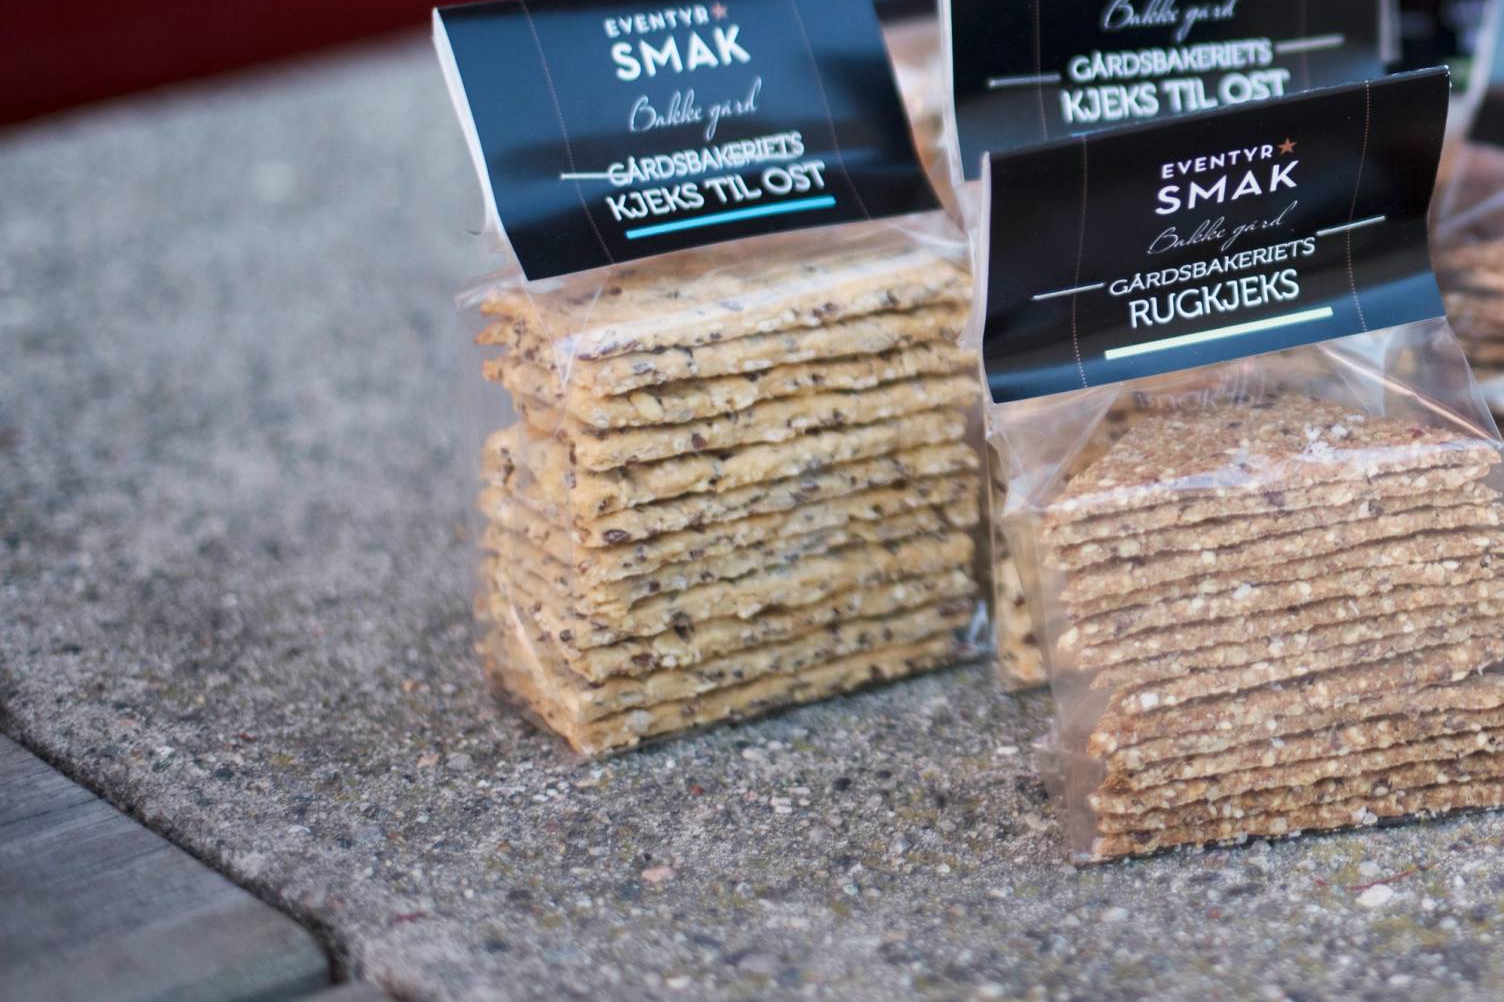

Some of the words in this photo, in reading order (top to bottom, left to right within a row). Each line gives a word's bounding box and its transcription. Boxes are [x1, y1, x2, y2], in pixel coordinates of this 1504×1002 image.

[605, 5, 708, 38] EVENTYR
[611, 25, 750, 81] SMAK
[1070, 39, 1273, 82] GÅRDSBAKERIETS
[1060, 83, 1159, 124] KJEKS
[1164, 78, 1219, 114] TIL
[1220, 69, 1290, 103] OST
[607, 132, 805, 187] GÅRDSBAKERIETS
[1154, 159, 1300, 215] SMAK
[1161, 144, 1274, 180] EVENTYR
[606, 183, 704, 222] KJEKS
[705, 171, 761, 206] TIL
[763, 160, 825, 194] OST
[1147, 215, 1225, 255] Bakke
[1109, 236, 1316, 297] GÅRDSBAKERIETS
[1128, 269, 1300, 329] RUGKJEKS
